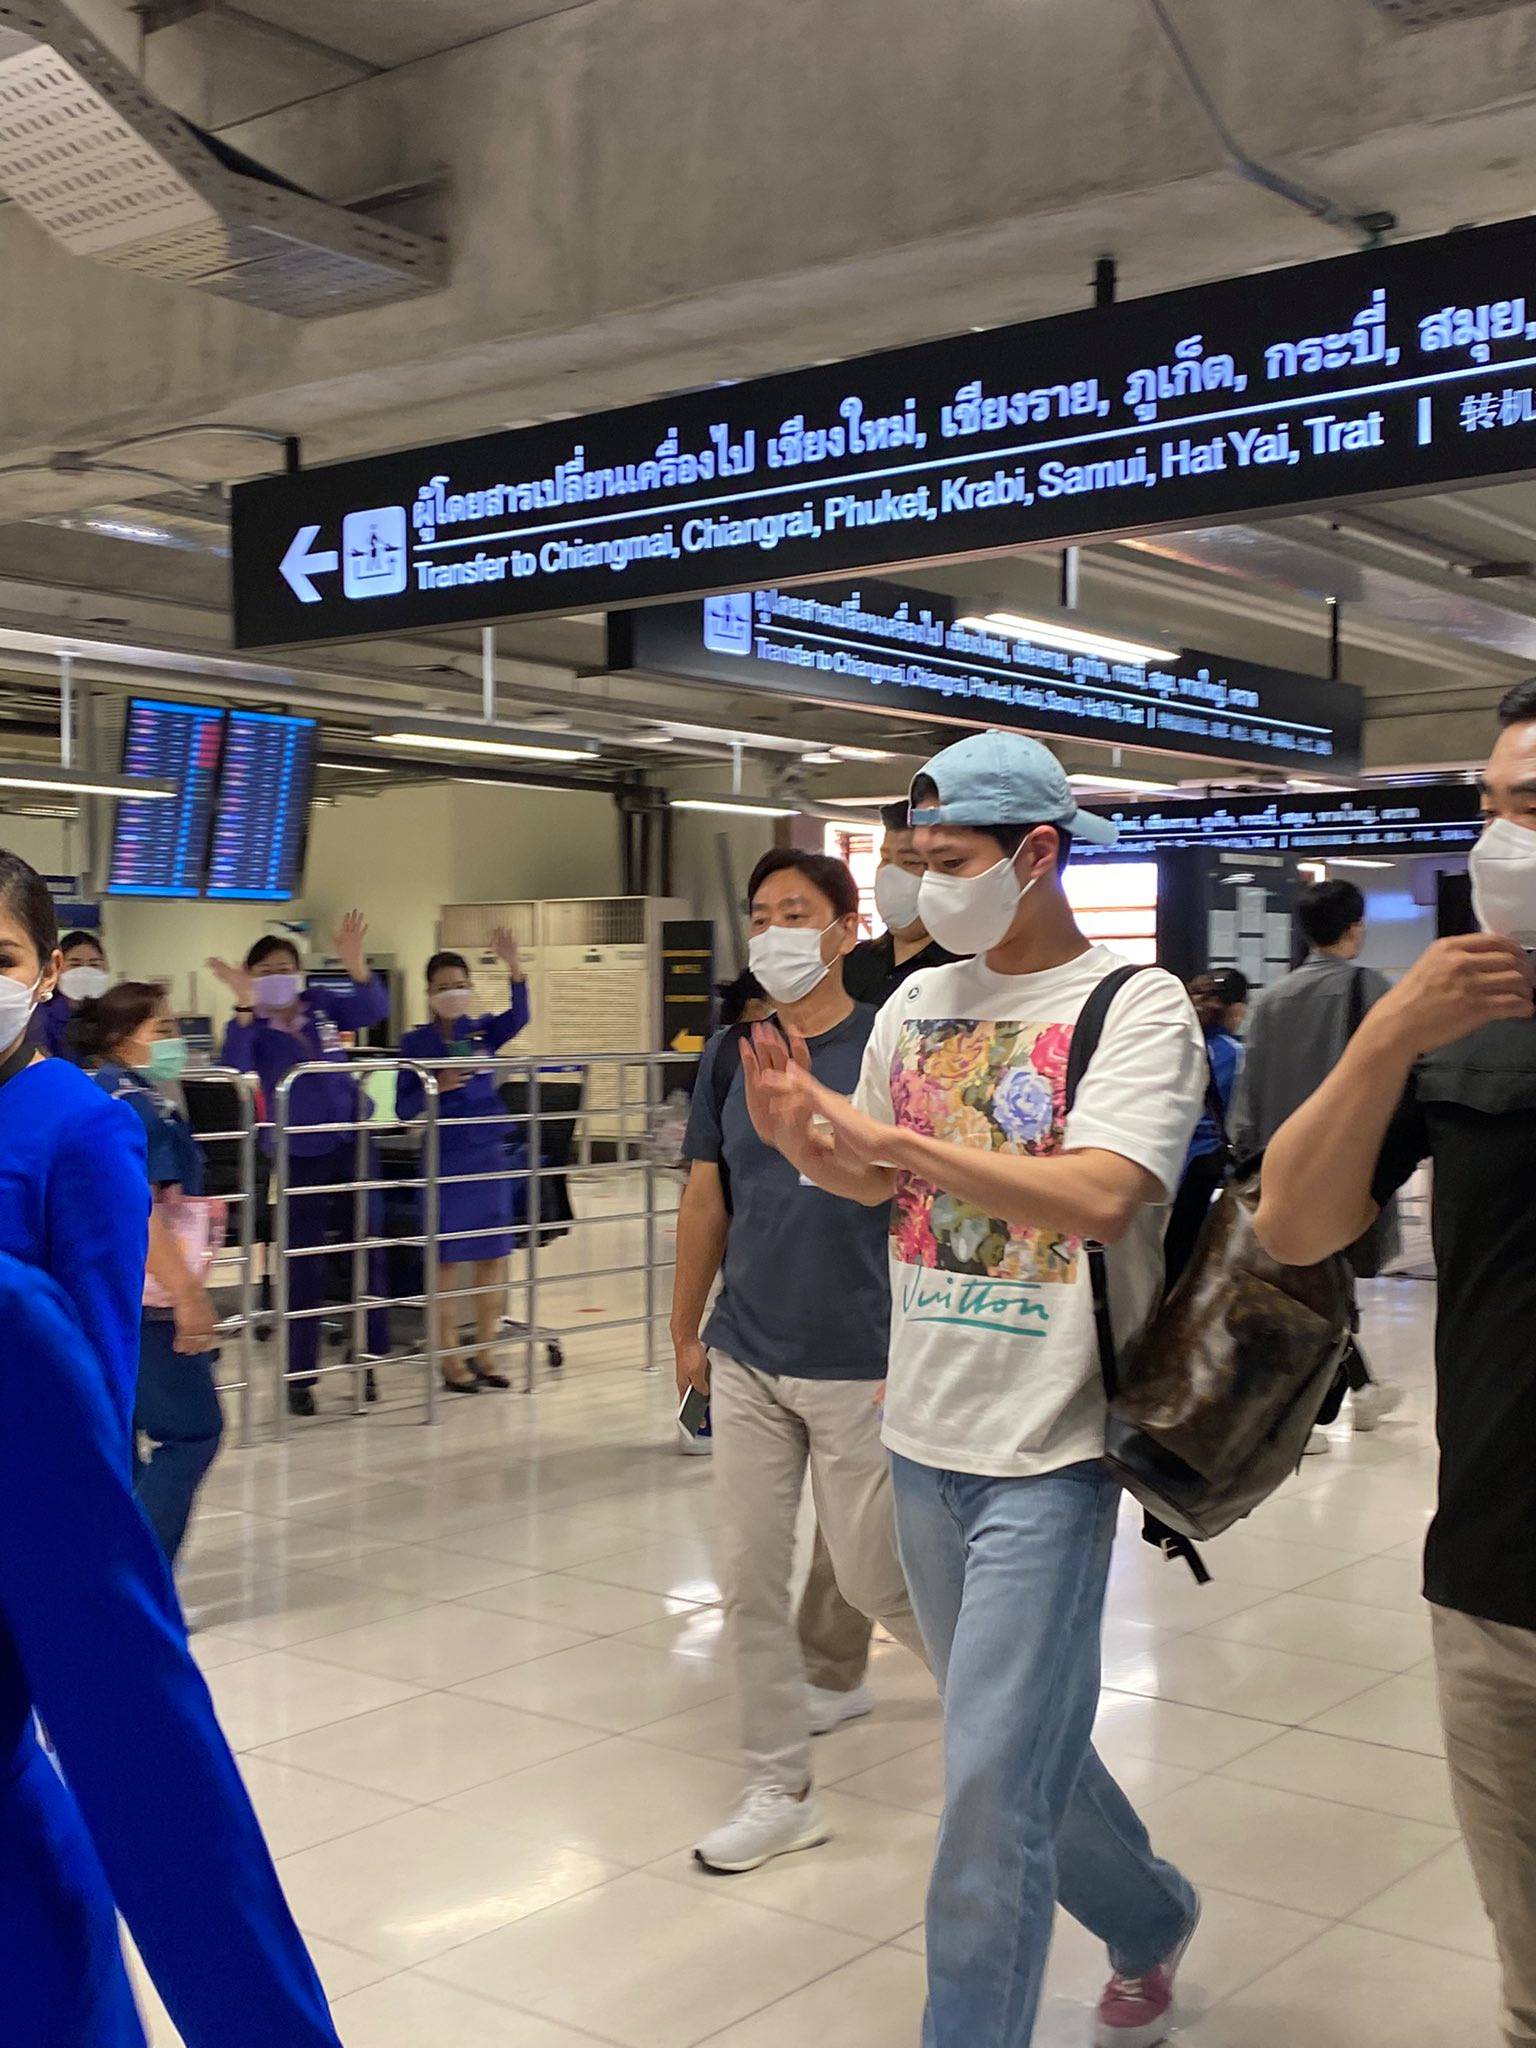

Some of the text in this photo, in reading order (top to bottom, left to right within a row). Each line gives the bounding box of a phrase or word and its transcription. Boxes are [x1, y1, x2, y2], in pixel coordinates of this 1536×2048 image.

[940, 380, 1110, 438] เชียงราย,
[1123, 334, 1248, 422] ภูเก็ต,
[1264, 288, 1400, 380] กระบี่,
[412, 411, 1385, 590] Transfer to Chiangmai, Chiangrai, Phuket, Krabi, Samui, Hat Yai, Trat
[903, 1264, 1050, 1321] Vuitton
